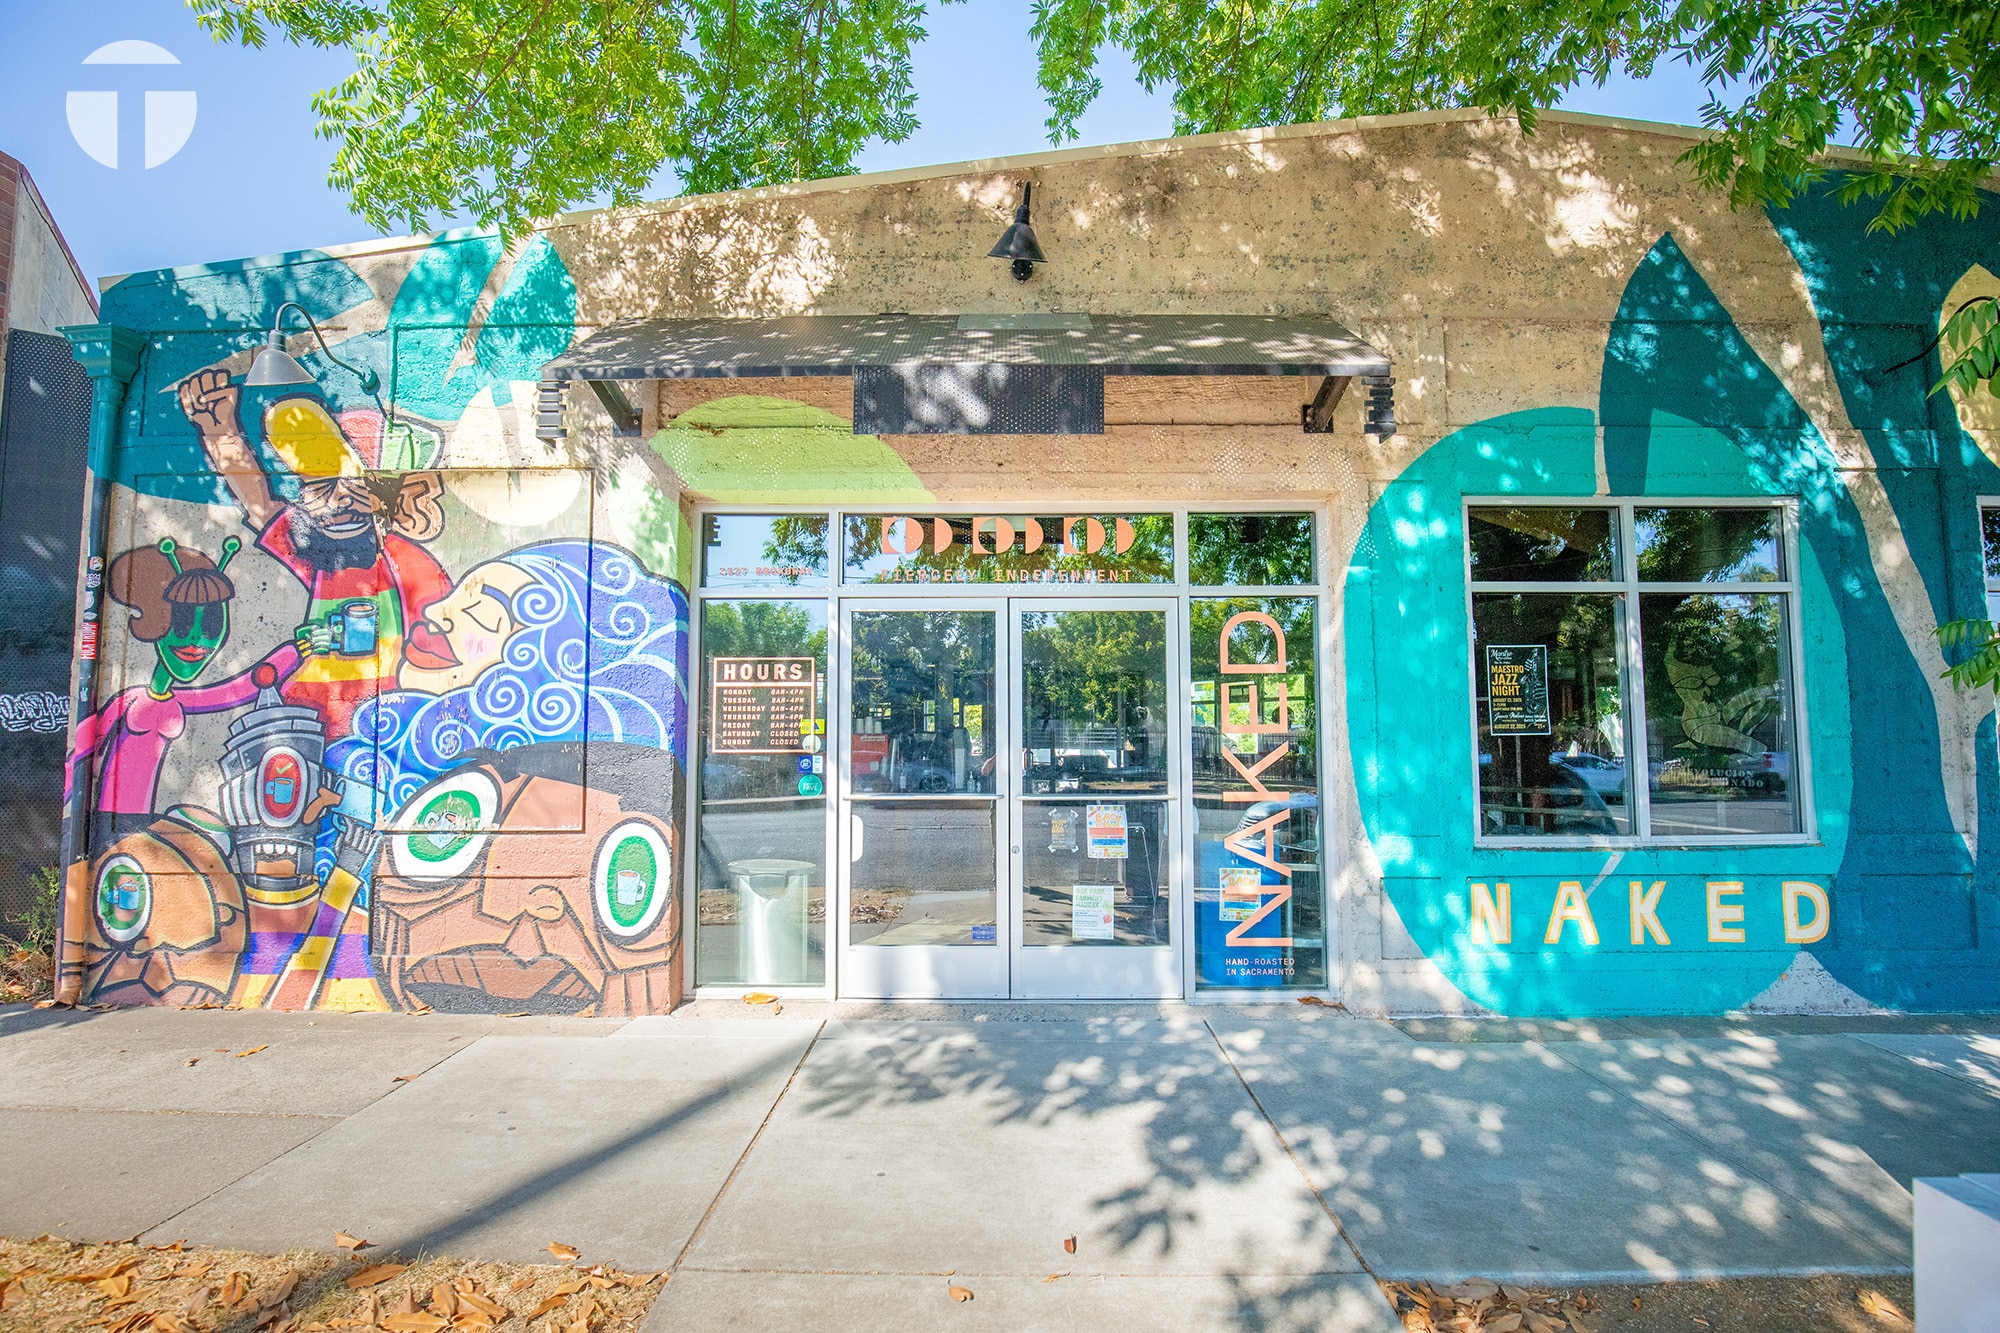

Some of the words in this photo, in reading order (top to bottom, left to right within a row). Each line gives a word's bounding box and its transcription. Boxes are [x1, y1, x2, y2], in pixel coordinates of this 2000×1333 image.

[755, 567, 812, 576] BROADWAY
[881, 569, 977, 582] FIERCELY
[994, 569, 1132, 582] INDEPENDENT
[723, 663, 803, 680] HOURS
[1491, 665, 1524, 673] MAESTRO
[1491, 673, 1518, 685] JAZZ
[1491, 685, 1520, 696] NIGHT
[1220, 611, 1294, 947] NAKED
[1471, 881, 1830, 945] NAKED
[1225, 958, 1295, 966] HAND-ROASTED
[1226, 968, 1236, 976] IN
[1240, 968, 1295, 976] SACRAMENTO
